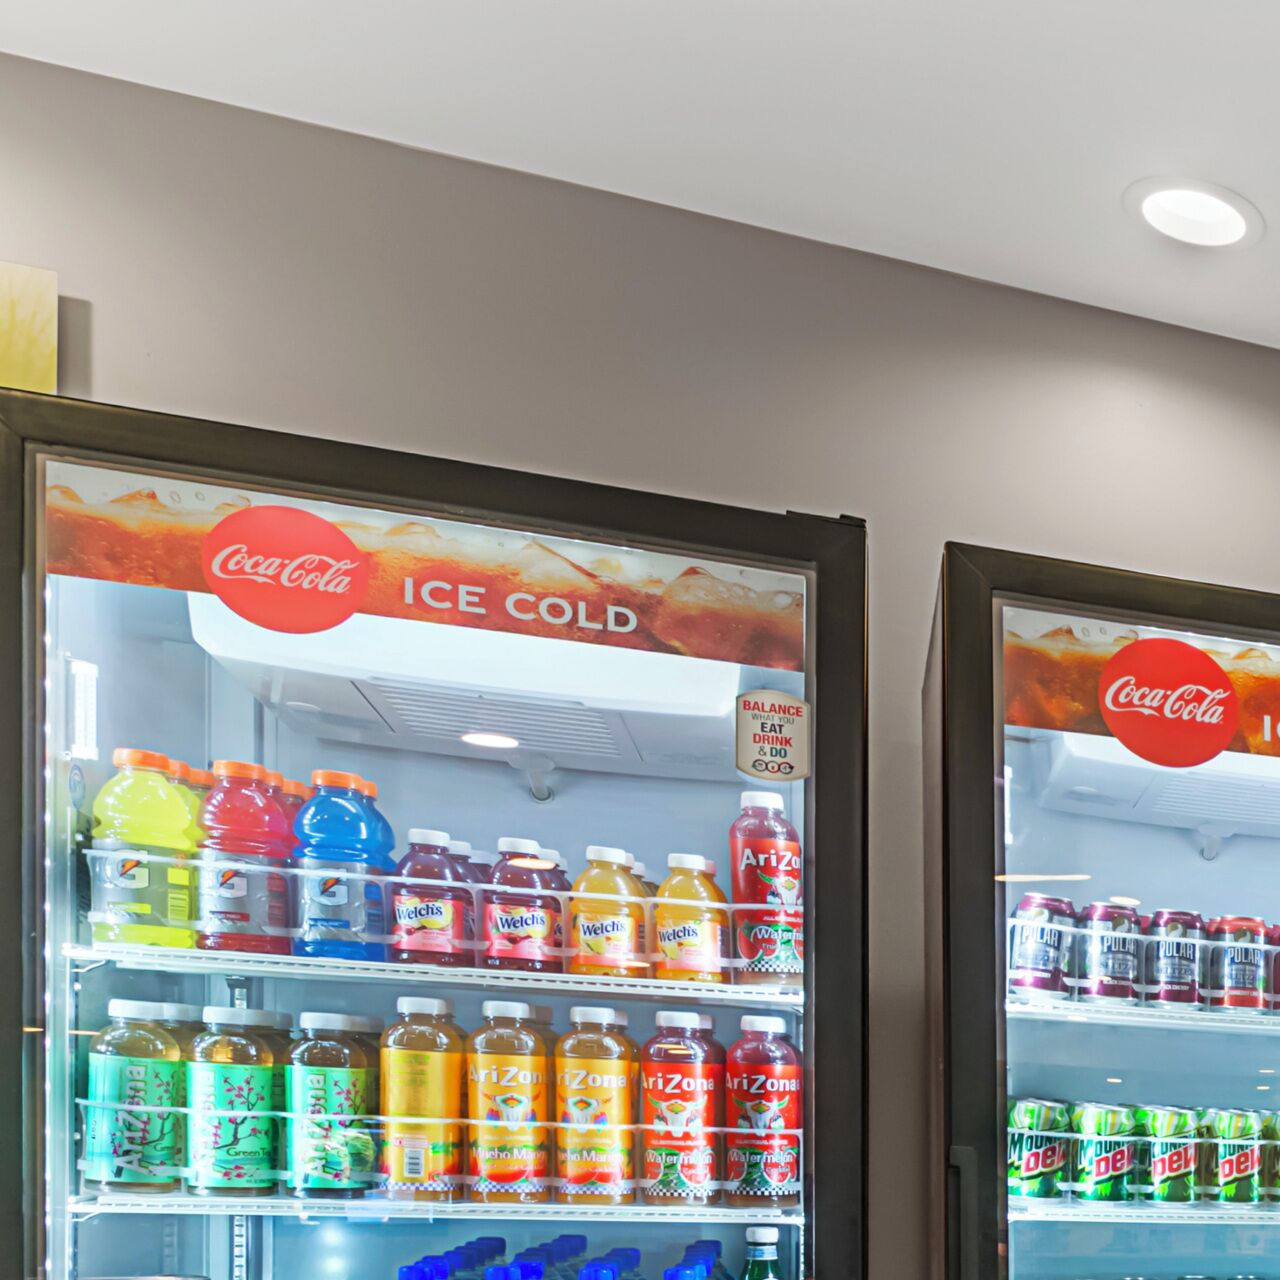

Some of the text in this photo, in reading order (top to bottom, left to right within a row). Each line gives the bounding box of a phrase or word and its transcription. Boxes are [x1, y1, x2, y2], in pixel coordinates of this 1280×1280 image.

[211, 543, 359, 594] Coca-Cola
[403, 576, 638, 634] ICE COLD
[742, 699, 804, 718] BALANCE
[1104, 675, 1231, 725] Coca-Cola
[751, 712, 796, 726] WHAT YOU
[760, 721, 784, 736] EAT
[752, 732, 794, 748] DRINK
[757, 745, 788, 760] & DO
[395, 902, 443, 921] Welch's
[499, 913, 545, 931] Welch's
[581, 920, 626, 937] Welch's
[658, 925, 699, 944] Welch's
